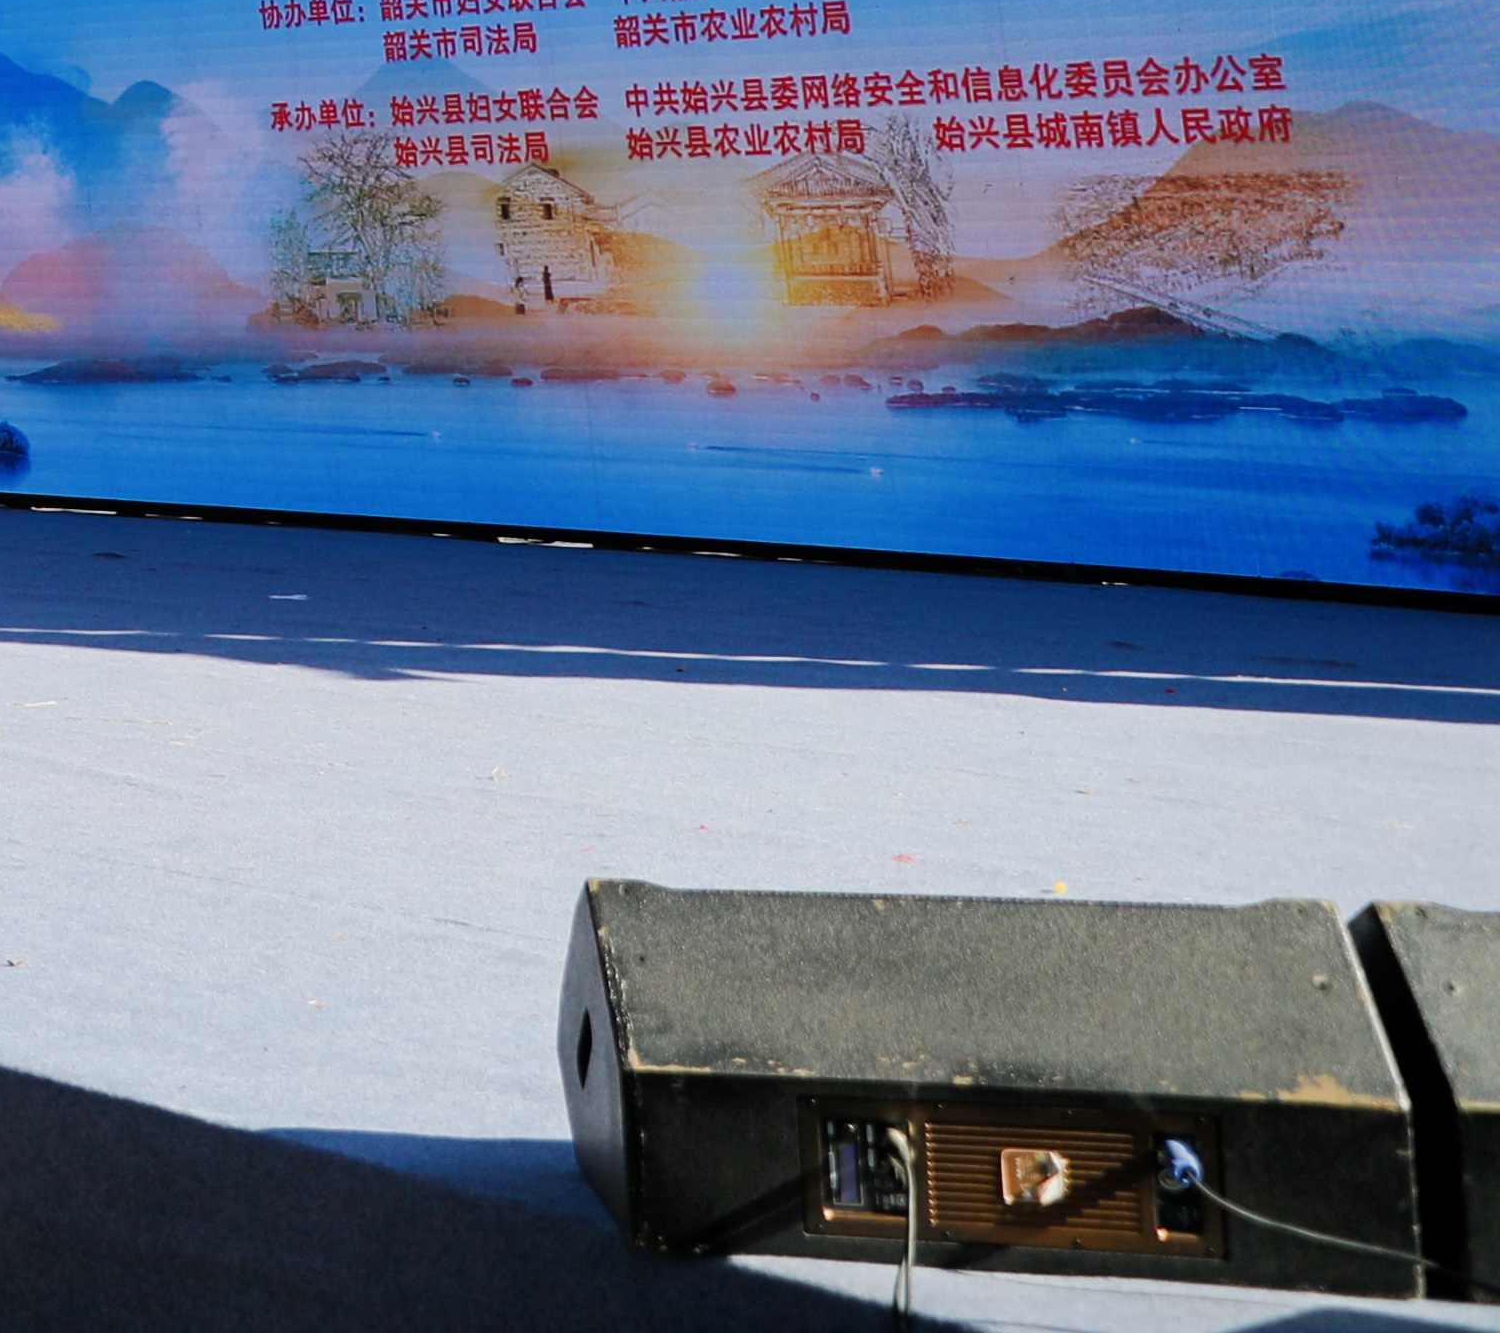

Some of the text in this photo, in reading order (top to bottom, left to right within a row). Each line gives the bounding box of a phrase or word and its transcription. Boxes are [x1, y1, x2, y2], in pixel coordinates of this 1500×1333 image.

[382, 0, 853, 63] 韶关市司法局 韶关市农业农村局
[624, 52, 1288, 118] 中共始兴县委网络安全和信息化委员会办公室
[392, 102, 1294, 169] 始兴县司法局 始兴县农业农村局 始兴县城南镇人民政府
